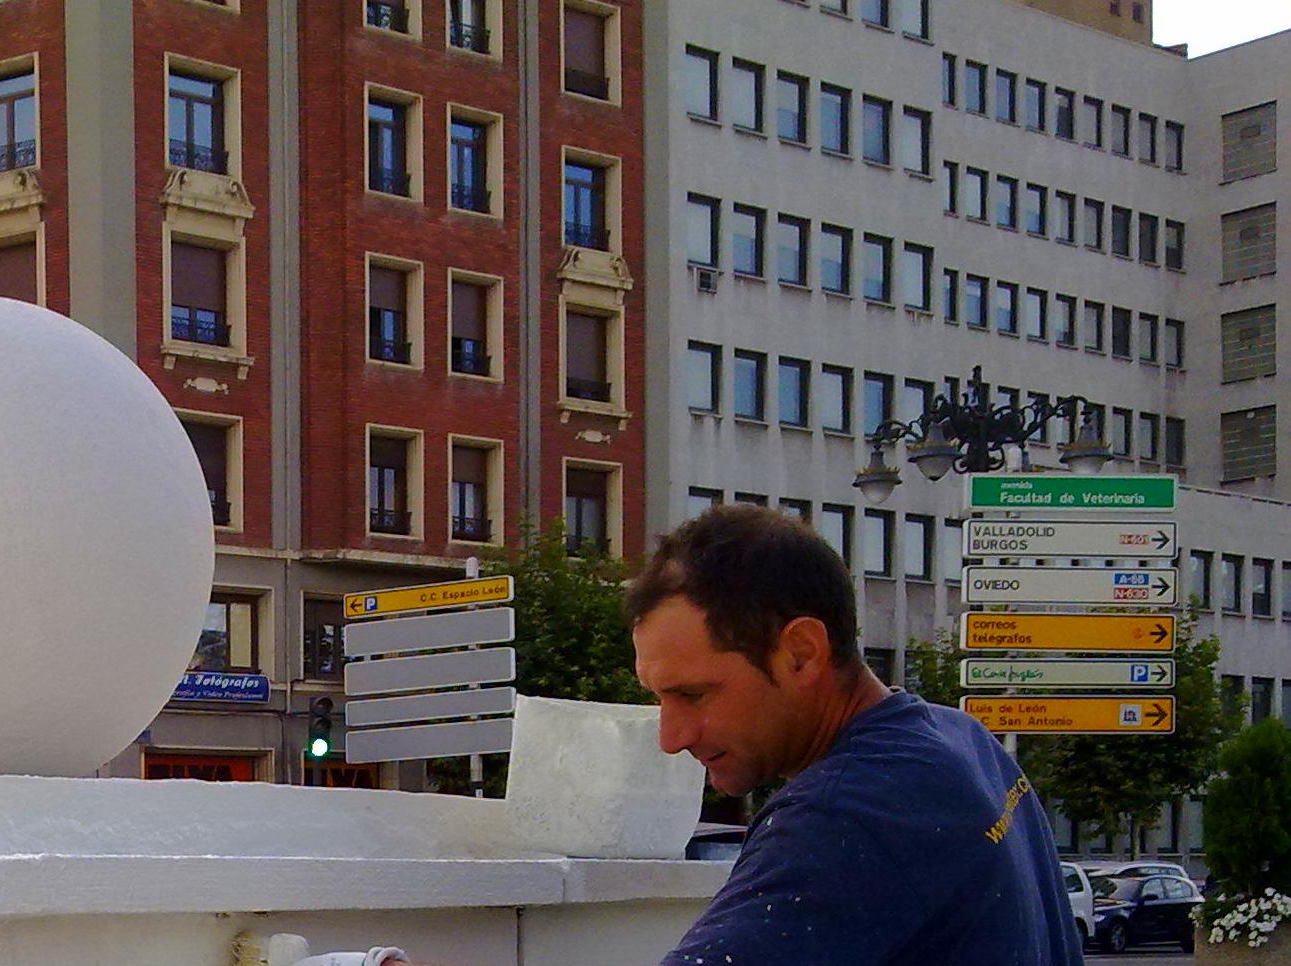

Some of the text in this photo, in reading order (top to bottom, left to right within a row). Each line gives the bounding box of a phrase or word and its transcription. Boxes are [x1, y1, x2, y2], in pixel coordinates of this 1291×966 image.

[1000, 492, 1052, 503] Facultad
[1060, 493, 1075, 504] de
[973, 527, 1055, 537] VALLADOLID
[972, 540, 1028, 550] BURGOS
[974, 580, 1020, 590] OVIEDO
[442, 588, 479, 600] Espacio
[482, 586, 505, 595] León
[1115, 589, 1148, 599] N-630
[973, 621, 1017, 629] correos
[970, 704, 1047, 713] Luis de León
[999, 716, 1022, 726] San
[1028, 717, 1074, 726] Antonio
